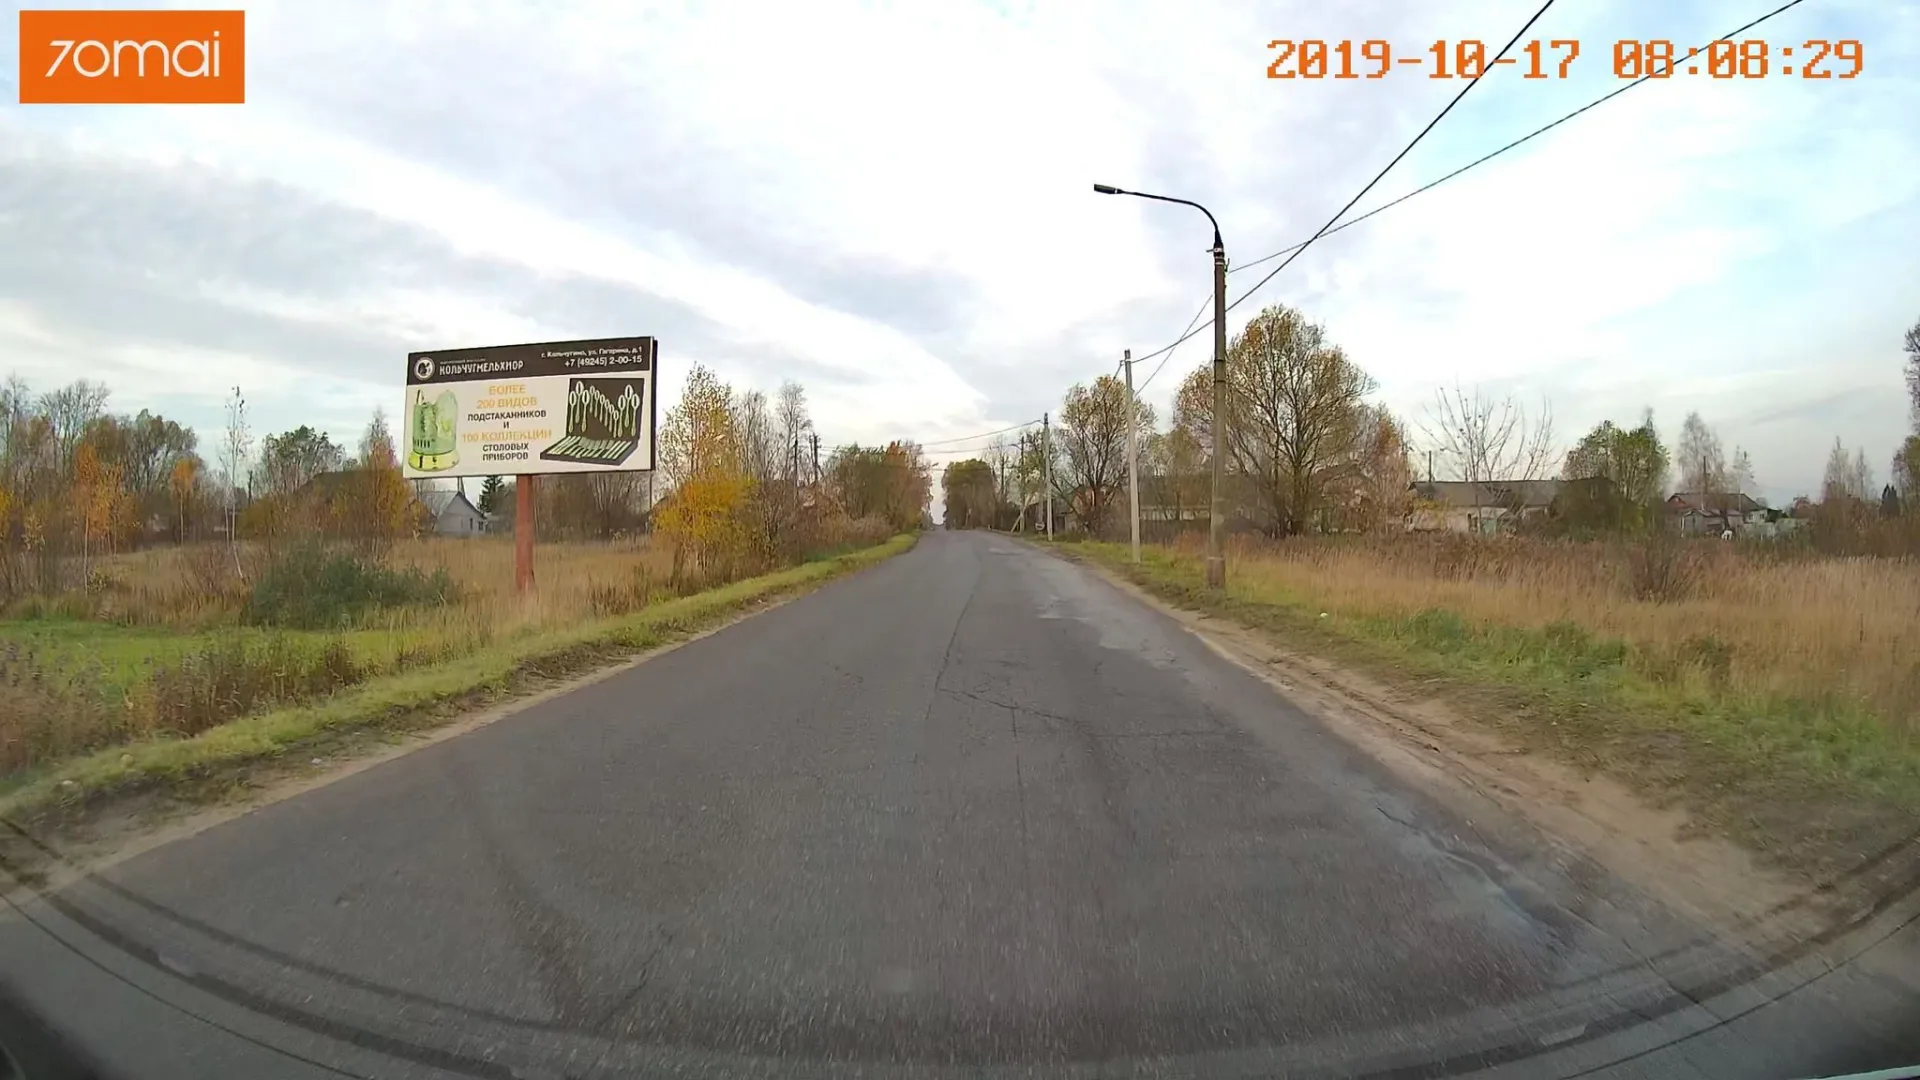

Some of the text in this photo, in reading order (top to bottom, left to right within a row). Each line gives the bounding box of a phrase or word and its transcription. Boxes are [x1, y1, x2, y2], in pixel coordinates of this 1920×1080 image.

[564, 355, 643, 368] +7 (49245) 2-00-15
[489, 385, 526, 395] БОЛЕЕ
[477, 397, 537, 409] 200 ВИДОВ
[467, 410, 547, 422] ПОДСТАКАННИКОВ
[503, 421, 510, 429] И
[463, 433, 479, 442] 100
[482, 443, 529, 452] СТОЛОВЫХ
[482, 452, 529, 461] ПРИБОРОВ
